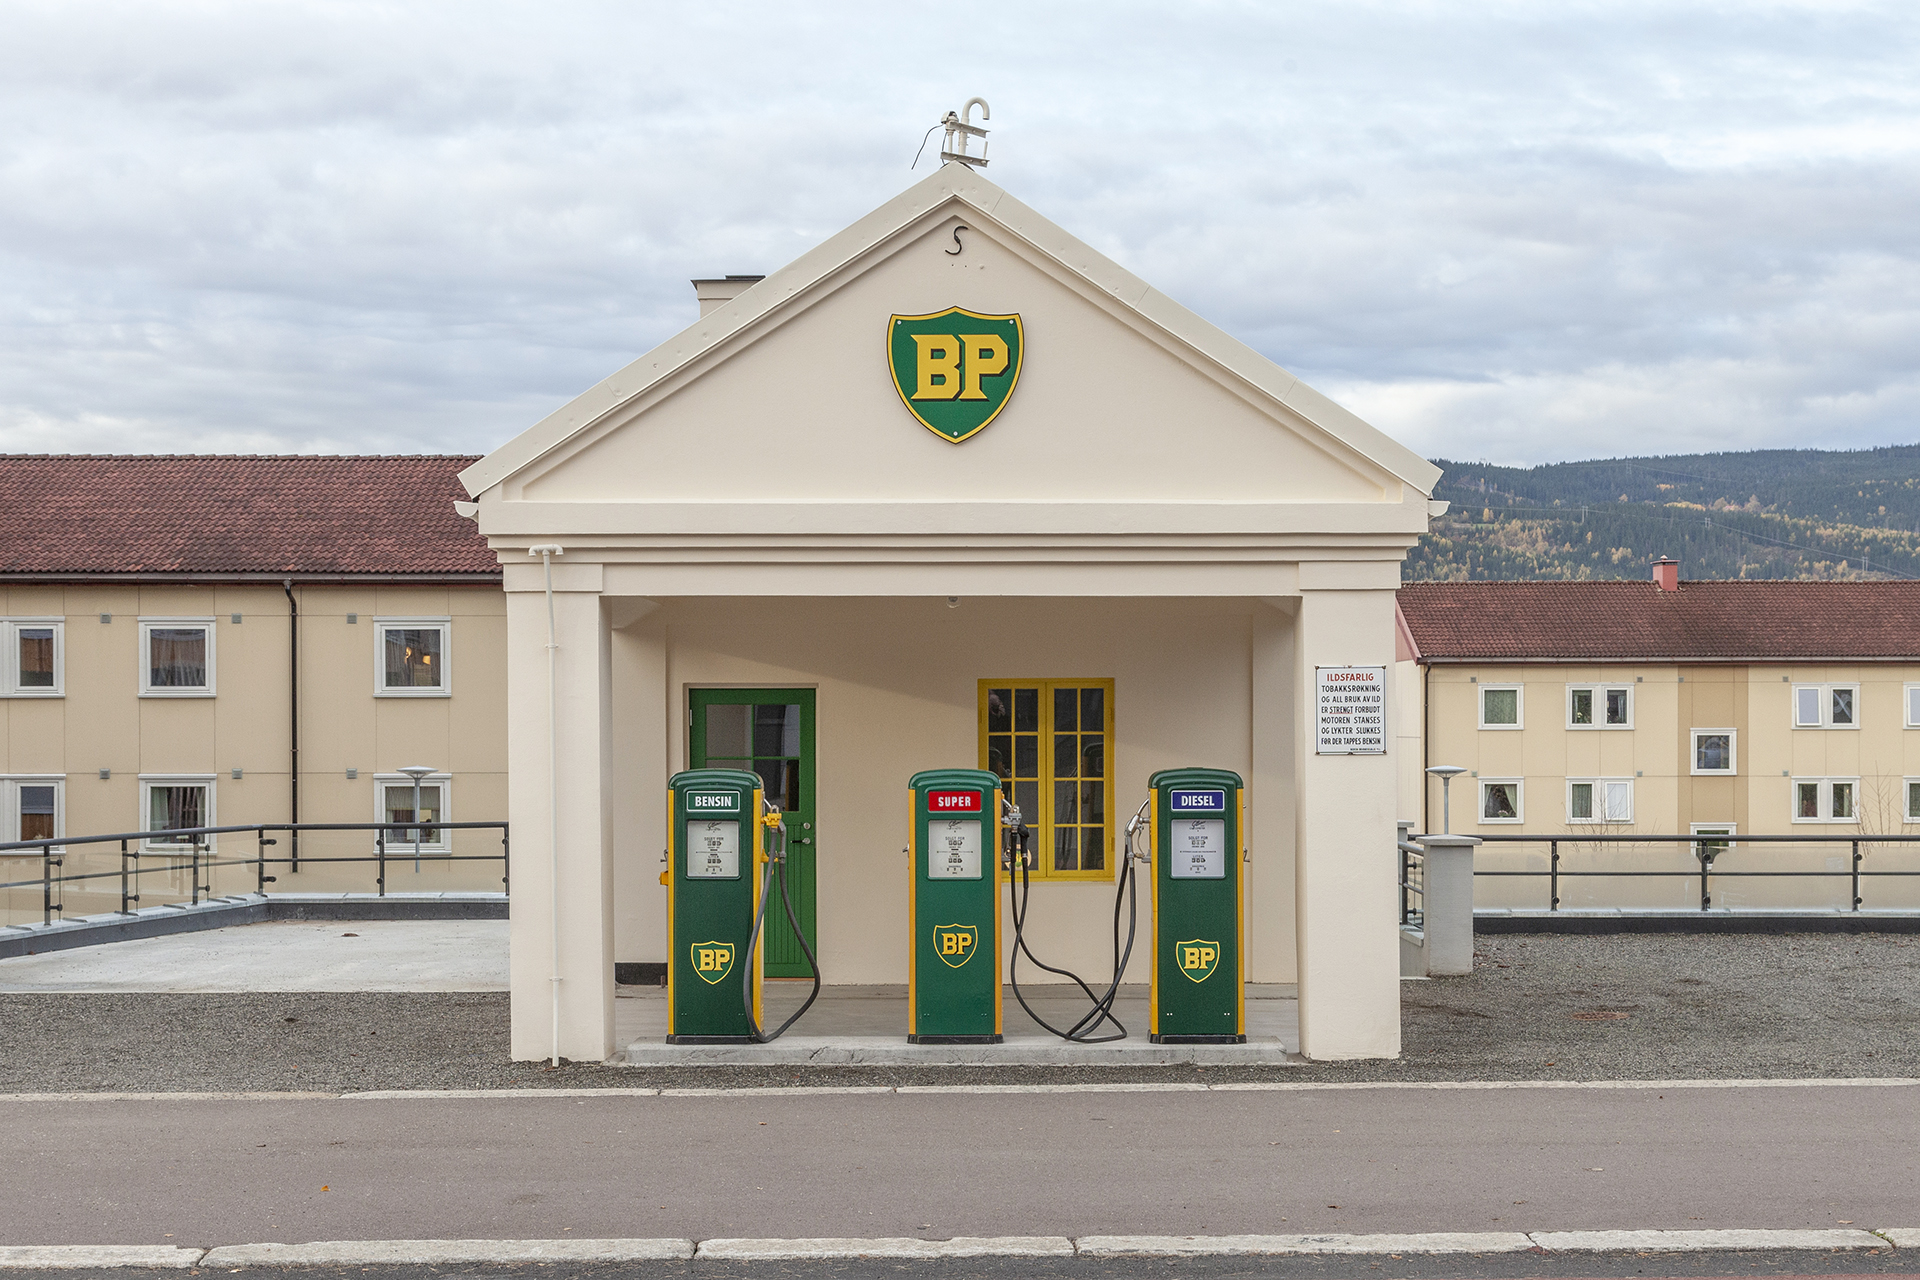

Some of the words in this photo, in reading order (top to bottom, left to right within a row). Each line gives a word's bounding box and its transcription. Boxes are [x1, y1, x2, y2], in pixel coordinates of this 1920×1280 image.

[910, 334, 1011, 402] BP
[1326, 673, 1374, 682] ILDSFARLIG
[695, 796, 732, 807] BENSIN
[938, 796, 971, 807] SUPER
[1181, 795, 1214, 806] DIESEL
[941, 932, 973, 955] BP
[698, 949, 730, 971] BP
[1183, 947, 1215, 969] BP
